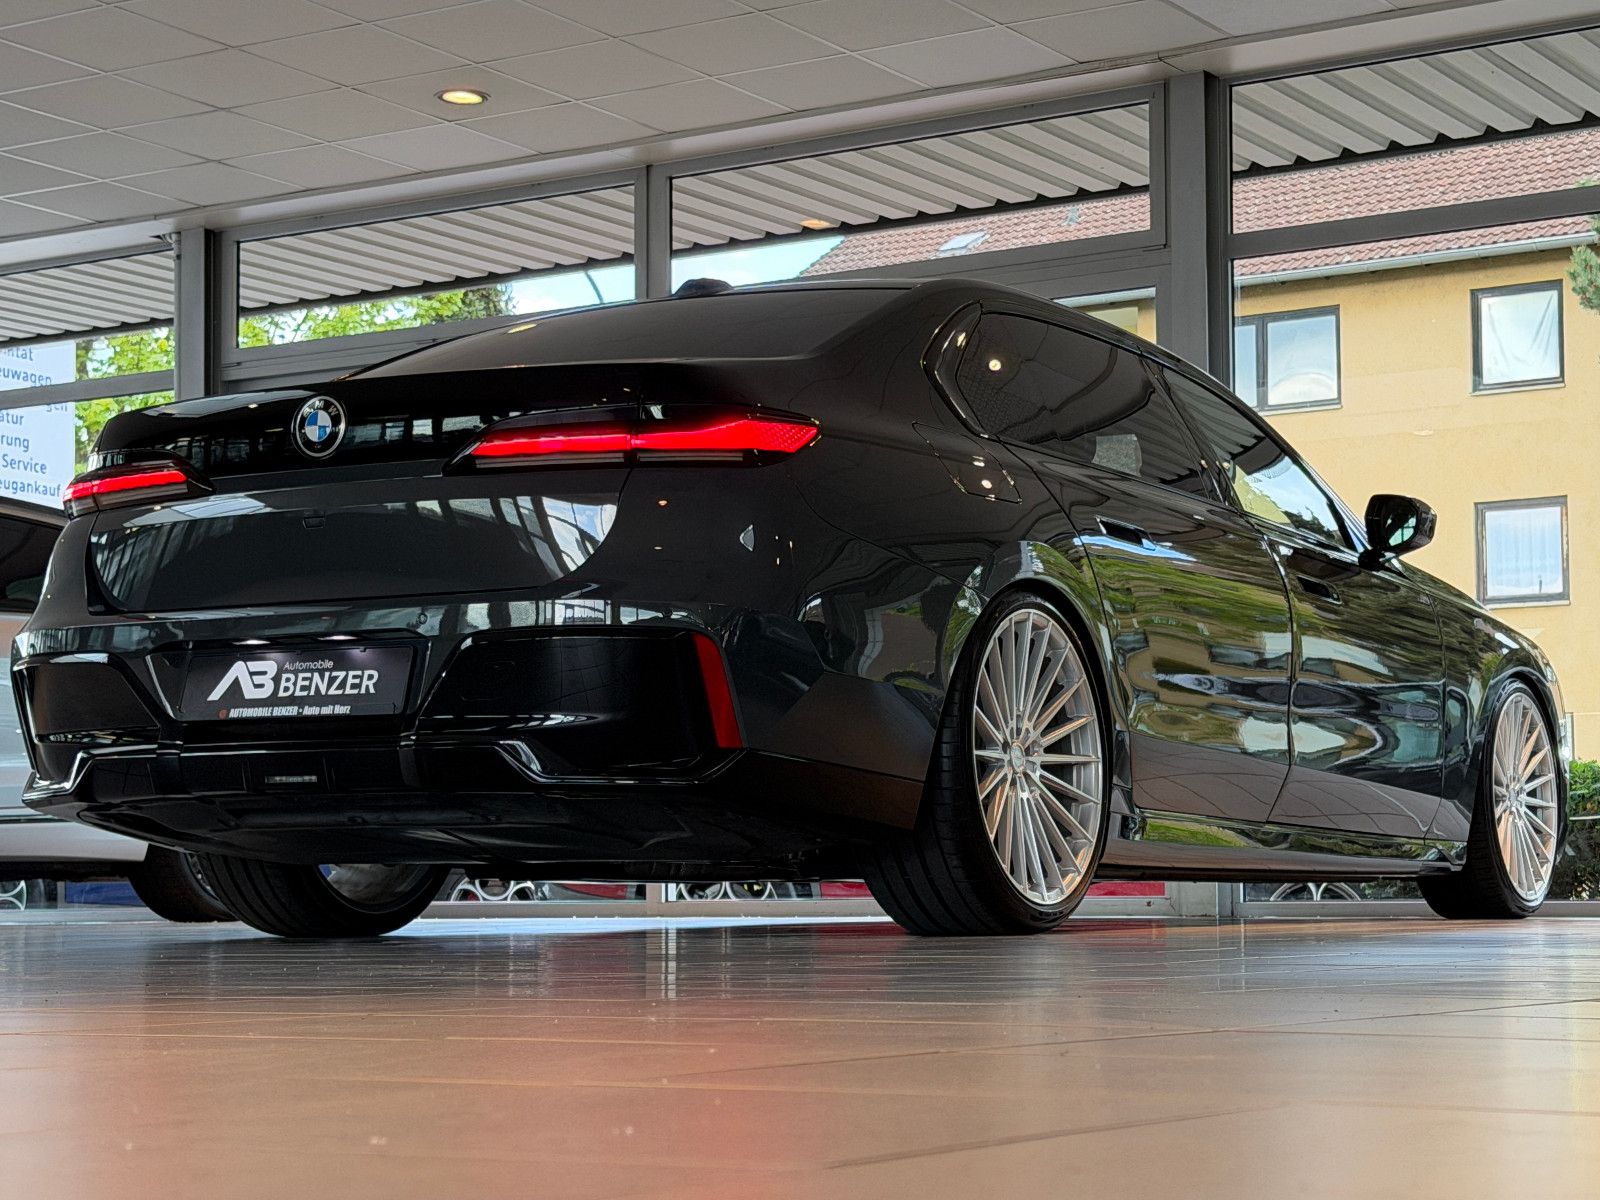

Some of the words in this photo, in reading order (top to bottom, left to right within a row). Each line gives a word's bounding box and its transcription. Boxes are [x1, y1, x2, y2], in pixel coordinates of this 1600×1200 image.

[0, 366, 52, 384] uwagen
[303, 400, 339, 418] BMW
[0, 435, 30, 453] rung
[2, 453, 47, 474] Service
[0, 479, 61, 497] ugankauf
[283, 659, 334, 670] Automobile
[277, 670, 379, 698] BENZER
[229, 707, 272, 718] AUTOMOBILE
[272, 706, 298, 716] BENZER
[303, 705, 320, 715] Auto
[320, 705, 333, 715] mit
[334, 704, 351, 714] Herz
